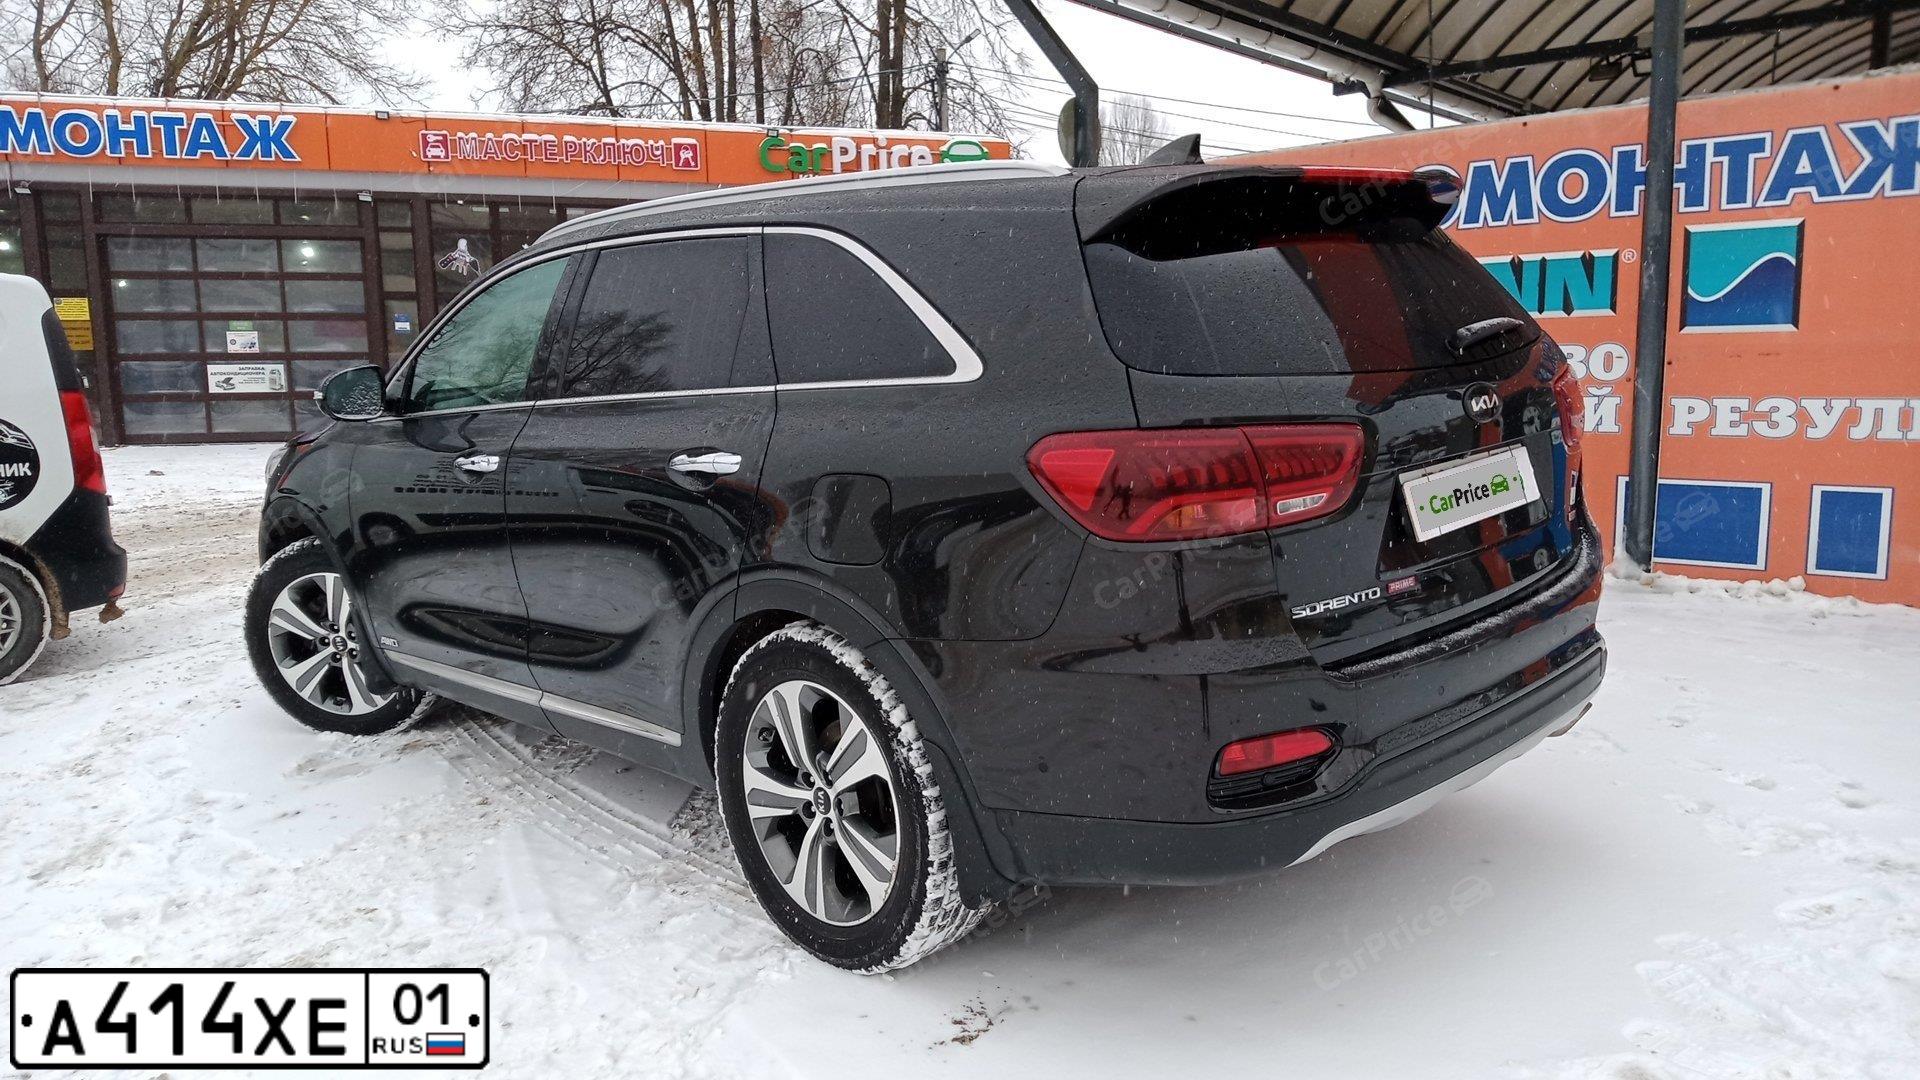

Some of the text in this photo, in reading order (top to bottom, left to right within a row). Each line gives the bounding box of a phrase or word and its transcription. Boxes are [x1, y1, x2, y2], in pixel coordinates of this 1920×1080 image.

[0, 105, 302, 162] МОНТАЖ
[456, 132, 671, 168] МАСТЕРКЛЮЧ
[759, 136, 933, 174] CarPrice
[1291, 576, 1416, 619] SORENTO PRIME
